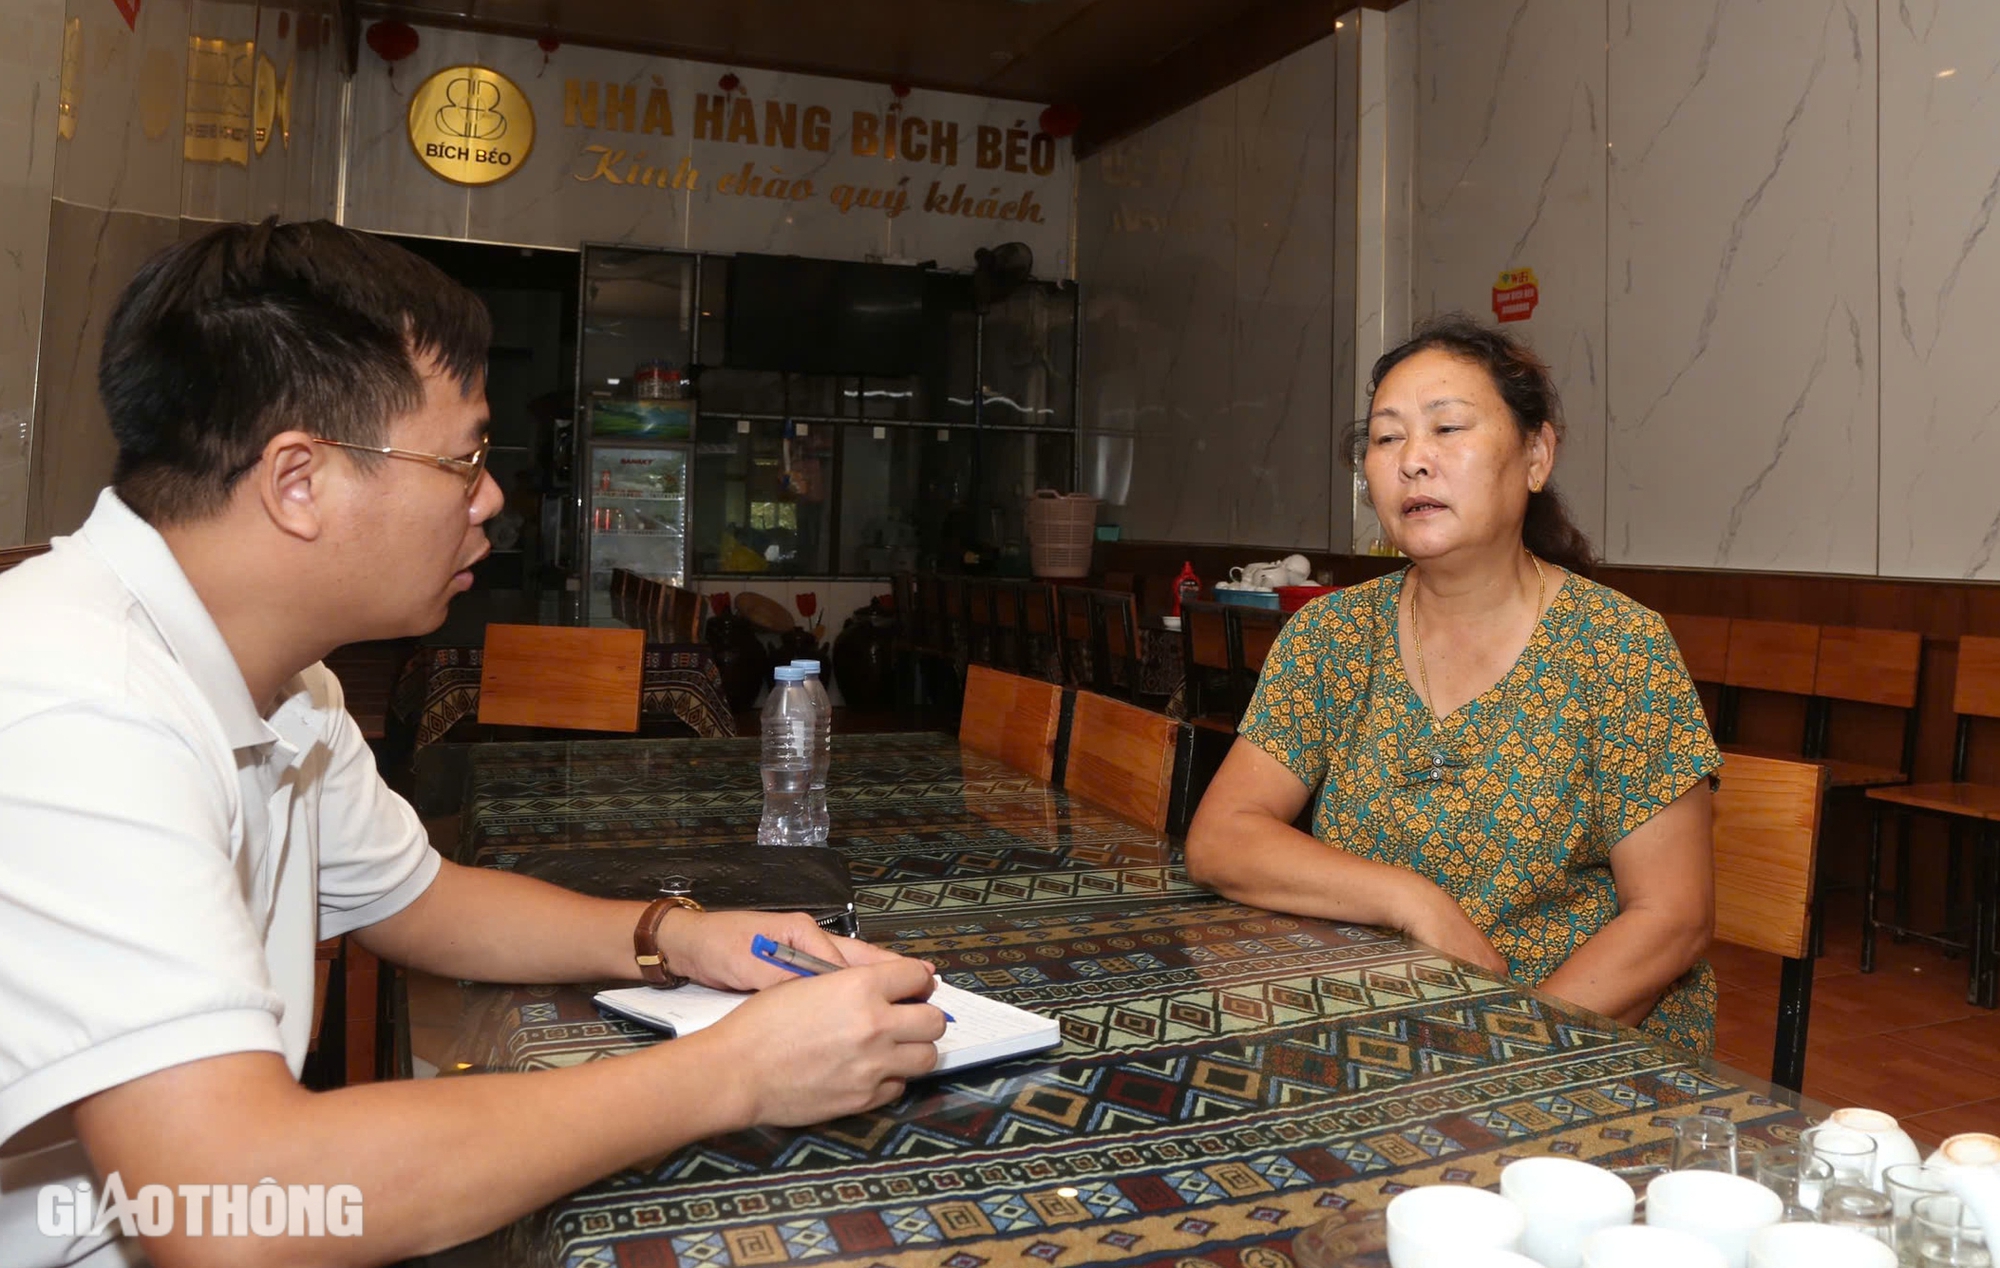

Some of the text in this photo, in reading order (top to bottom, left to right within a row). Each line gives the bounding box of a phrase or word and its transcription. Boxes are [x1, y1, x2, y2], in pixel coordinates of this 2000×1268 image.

[425, 142, 470, 161] BÍCH
[563, 73, 1055, 176] NHÀ HÀNG BÍCH BÉO
[573, 144, 700, 191] Kính
[717, 161, 816, 202] chào
[830, 176, 911, 218] quý
